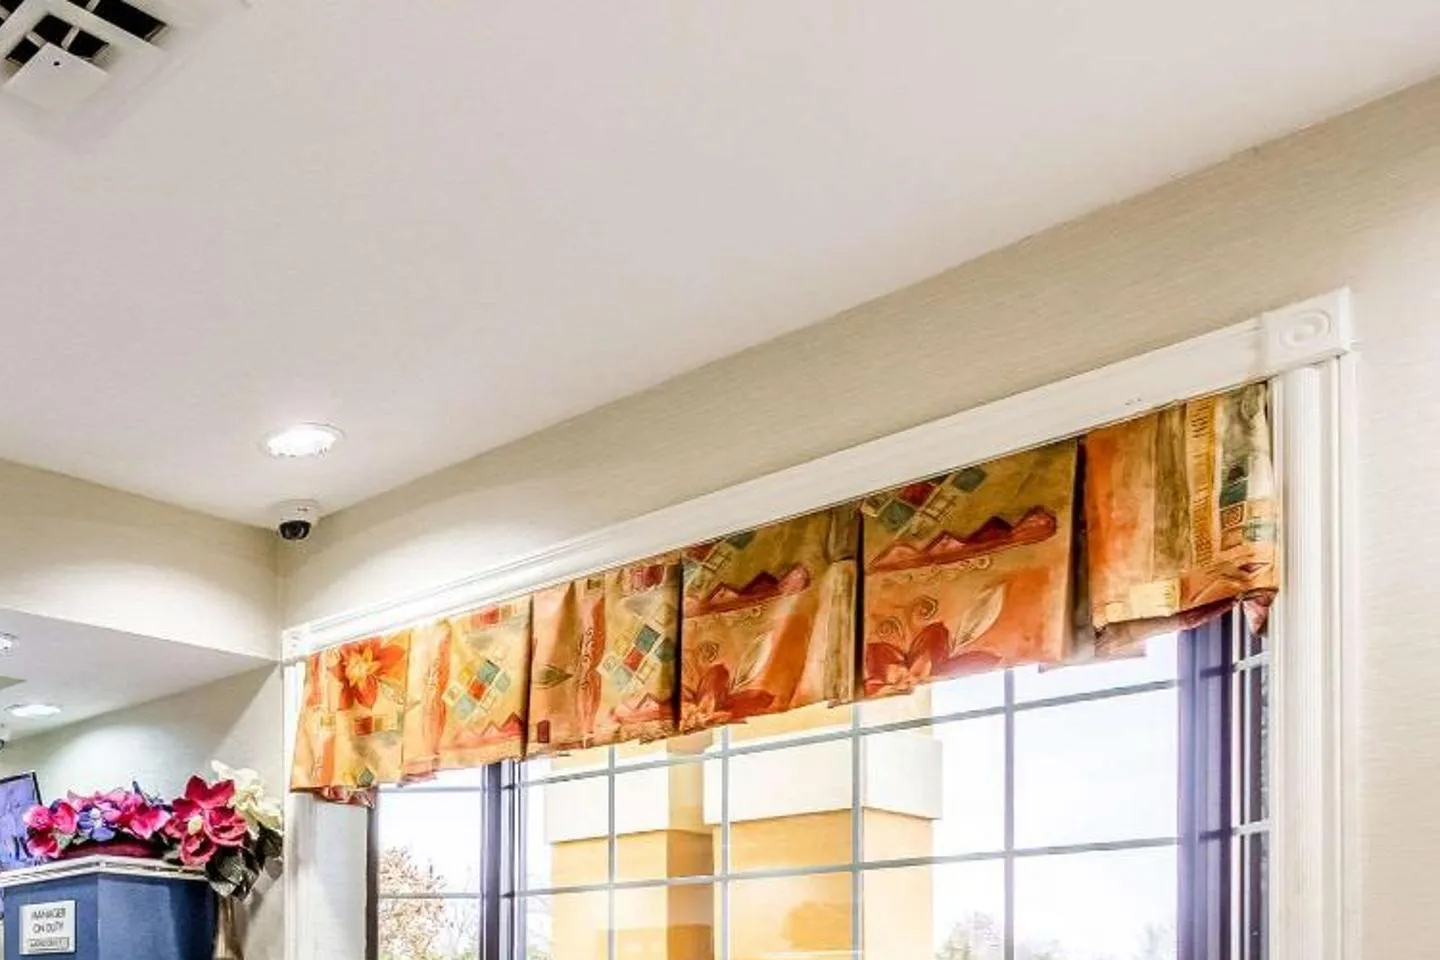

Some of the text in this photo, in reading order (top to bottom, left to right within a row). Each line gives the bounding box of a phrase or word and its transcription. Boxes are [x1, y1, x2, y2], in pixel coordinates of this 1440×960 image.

[31, 907, 66, 920] MANAGER
[32, 921, 64, 933] ON DUTY
